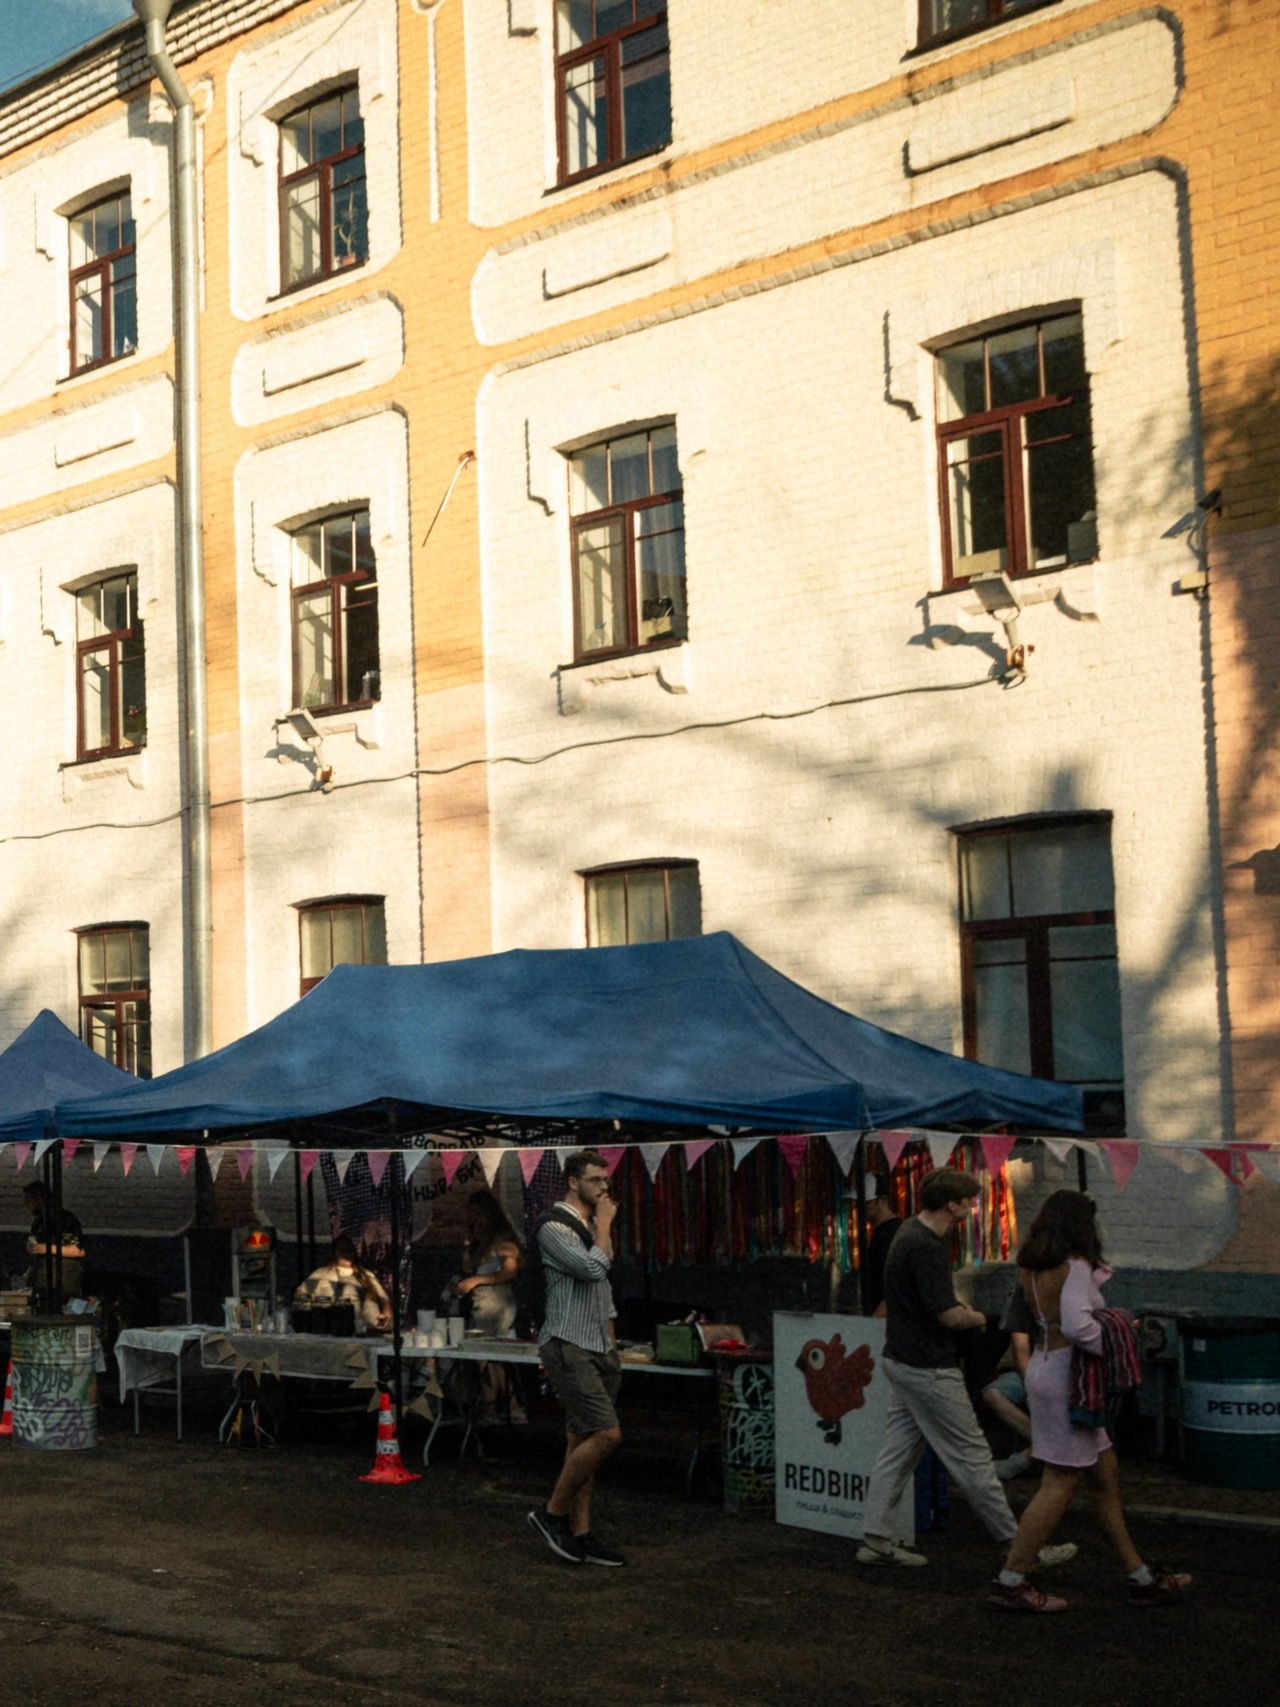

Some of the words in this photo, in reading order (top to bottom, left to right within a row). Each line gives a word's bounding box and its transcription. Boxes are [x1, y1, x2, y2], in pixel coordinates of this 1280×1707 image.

[456, 1155, 481, 1184] БИ
[1207, 1399, 1280, 1416] PETRO
[785, 1462, 870, 1503] REDBIR
